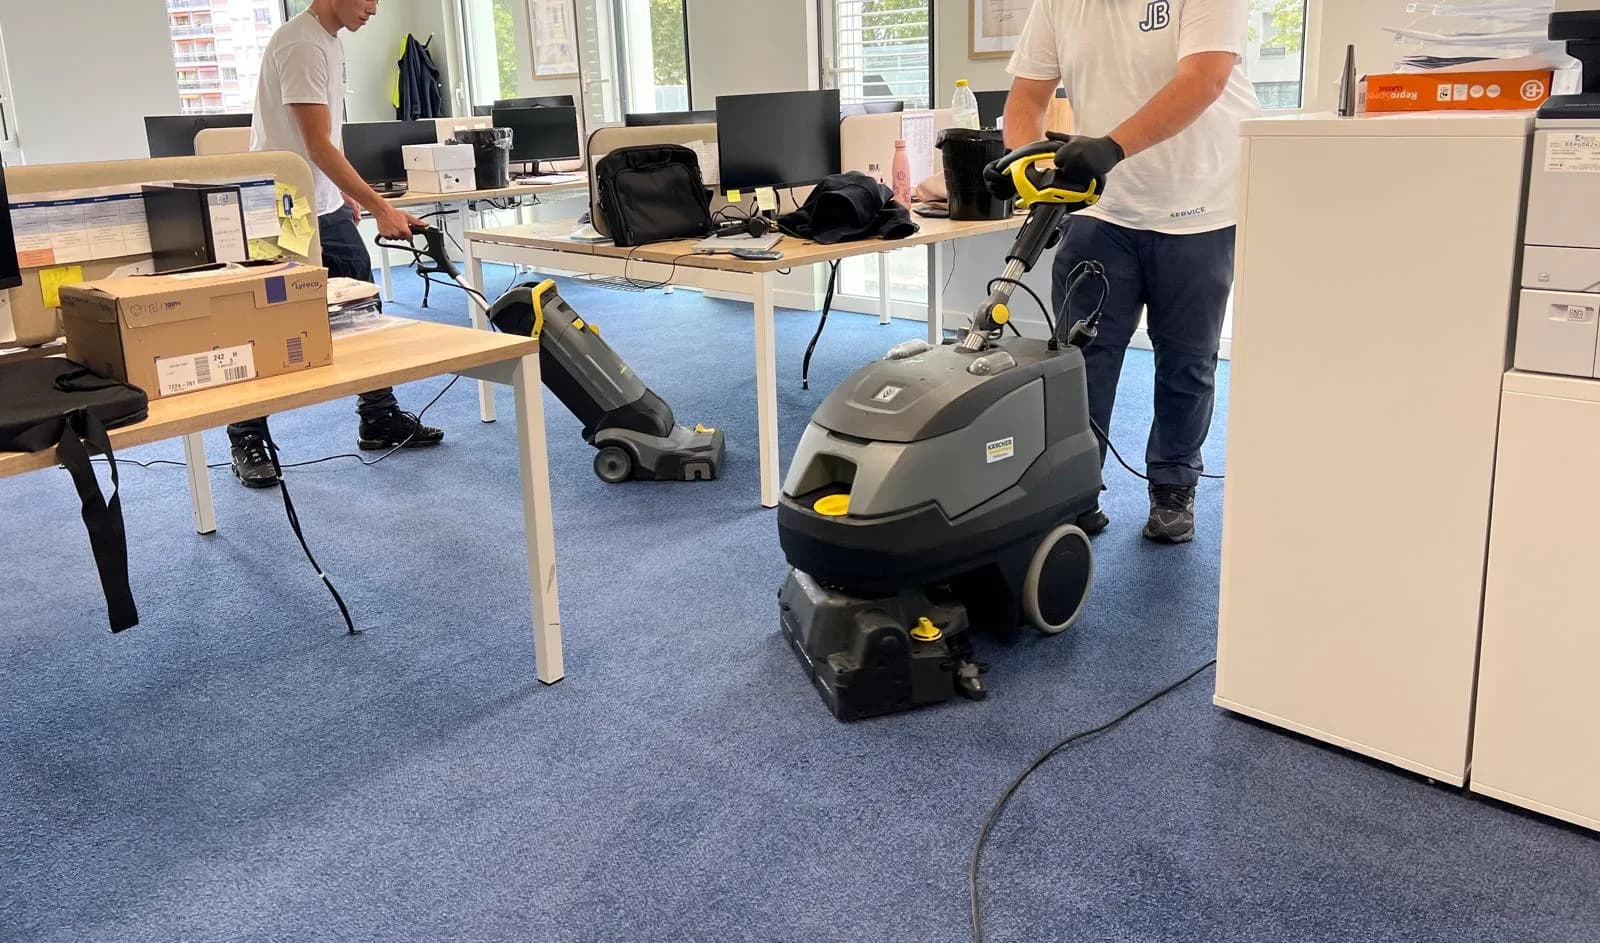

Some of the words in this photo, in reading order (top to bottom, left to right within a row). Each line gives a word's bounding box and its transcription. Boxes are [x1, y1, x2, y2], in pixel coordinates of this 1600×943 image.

[1139, 0, 1170, 32] JB
[1170, 206, 1206, 218] SERVICE
[295, 281, 320, 290] Lyreco
